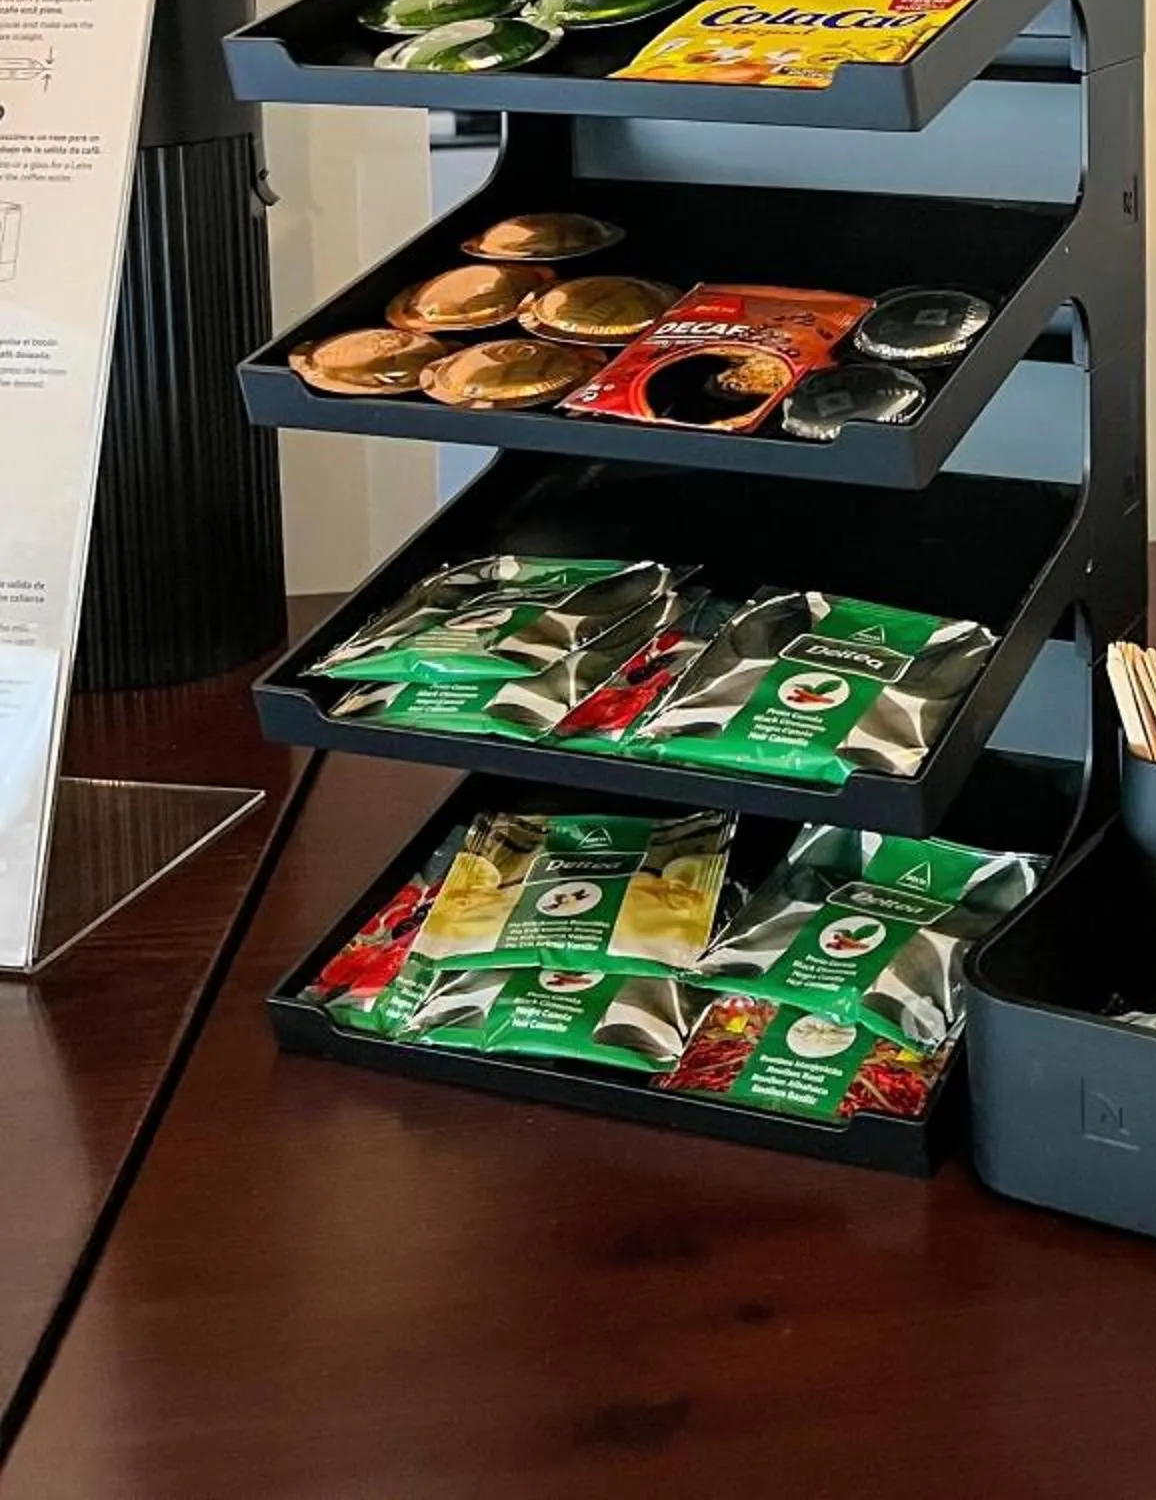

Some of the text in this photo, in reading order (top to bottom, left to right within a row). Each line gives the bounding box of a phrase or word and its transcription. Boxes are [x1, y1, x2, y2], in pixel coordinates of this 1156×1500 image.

[700, 4, 928, 30] ColaCao
[653, 321, 751, 336] DECAF
[805, 644, 885, 671] Deltea
